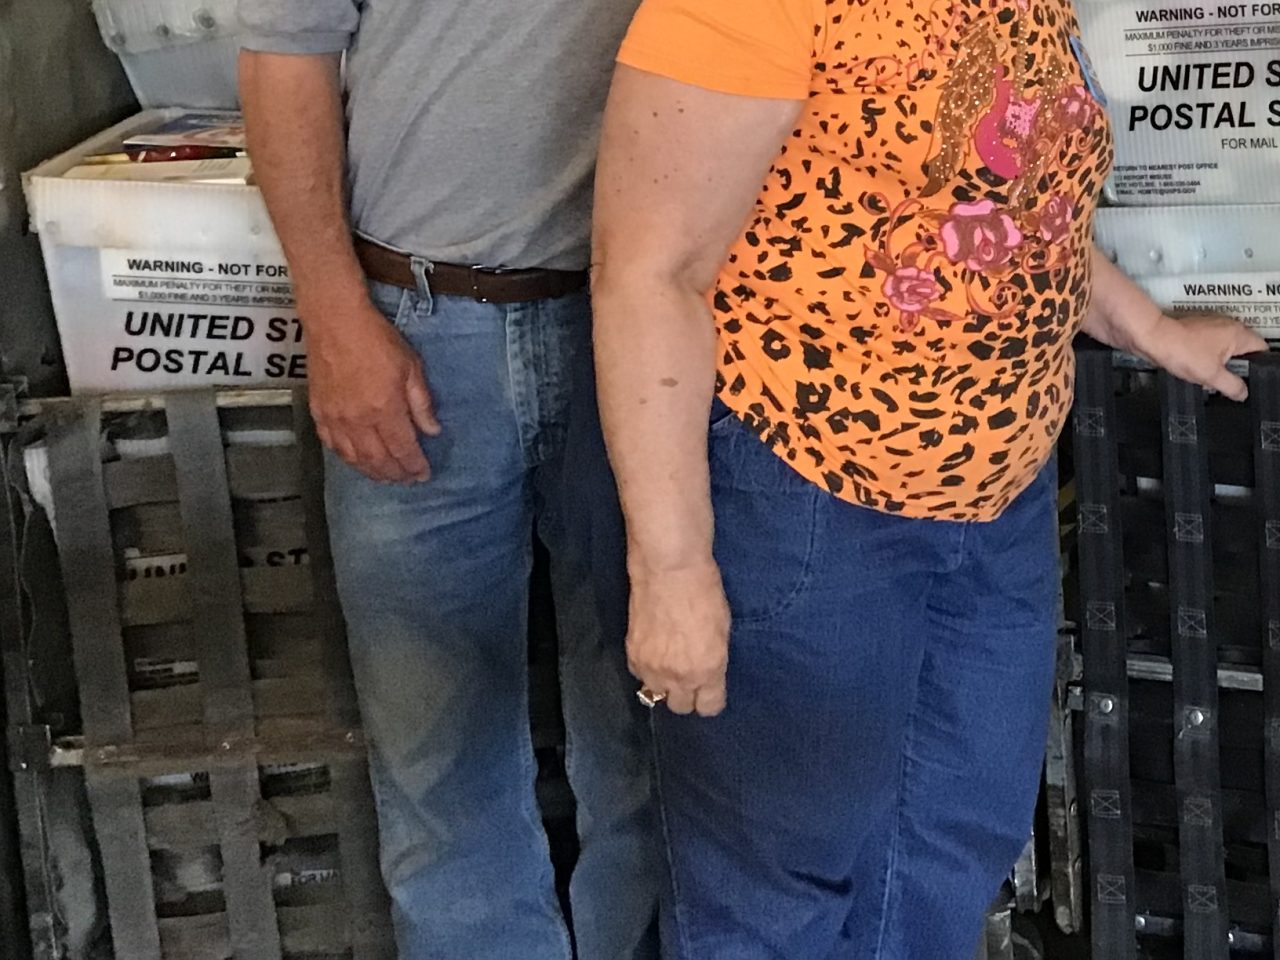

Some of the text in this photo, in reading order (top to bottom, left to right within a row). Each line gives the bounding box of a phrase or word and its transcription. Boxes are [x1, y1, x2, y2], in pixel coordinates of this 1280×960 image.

[1136, 7, 1204, 22] WARNING
[1217, 5, 1247, 18] NOT
[1125, 31, 1165, 41] MAXIMUM
[1167, 29, 1203, 39] PENALTY
[1205, 28, 1222, 37] FOR
[1224, 26, 1250, 36] THEFT
[1252, 26, 1266, 35] OR
[1174, 41, 1193, 51] FINE
[1194, 40, 1212, 50] AND
[1213, 40, 1219, 49] 3
[1219, 38, 1249, 48] YEARS
[1138, 62, 1255, 92] UNITED
[1129, 102, 1256, 131] POSTAL
[1221, 138, 1247, 150] FOR
[1250, 137, 1278, 149] MAIL
[127, 258, 204, 275] WARNING
[218, 263, 251, 277] NOT
[256, 264, 289, 278] FOR
[113, 278, 158, 288] MAXIMUM
[159, 279, 201, 290] PENALTY
[202, 280, 223, 290] FOR
[225, 281, 253, 292] THEFT
[255, 283, 270, 293] OR
[1183, 284, 1253, 296] WARNING
[168, 292, 185, 301] FINE
[185, 292, 209, 302] AND
[219, 294, 250, 304] YEARS
[1215, 304, 1252, 313] PENALTY
[1254, 305, 1272, 313] FOR
[124, 311, 255, 341] UNITED
[110, 346, 252, 377] POSTAL
